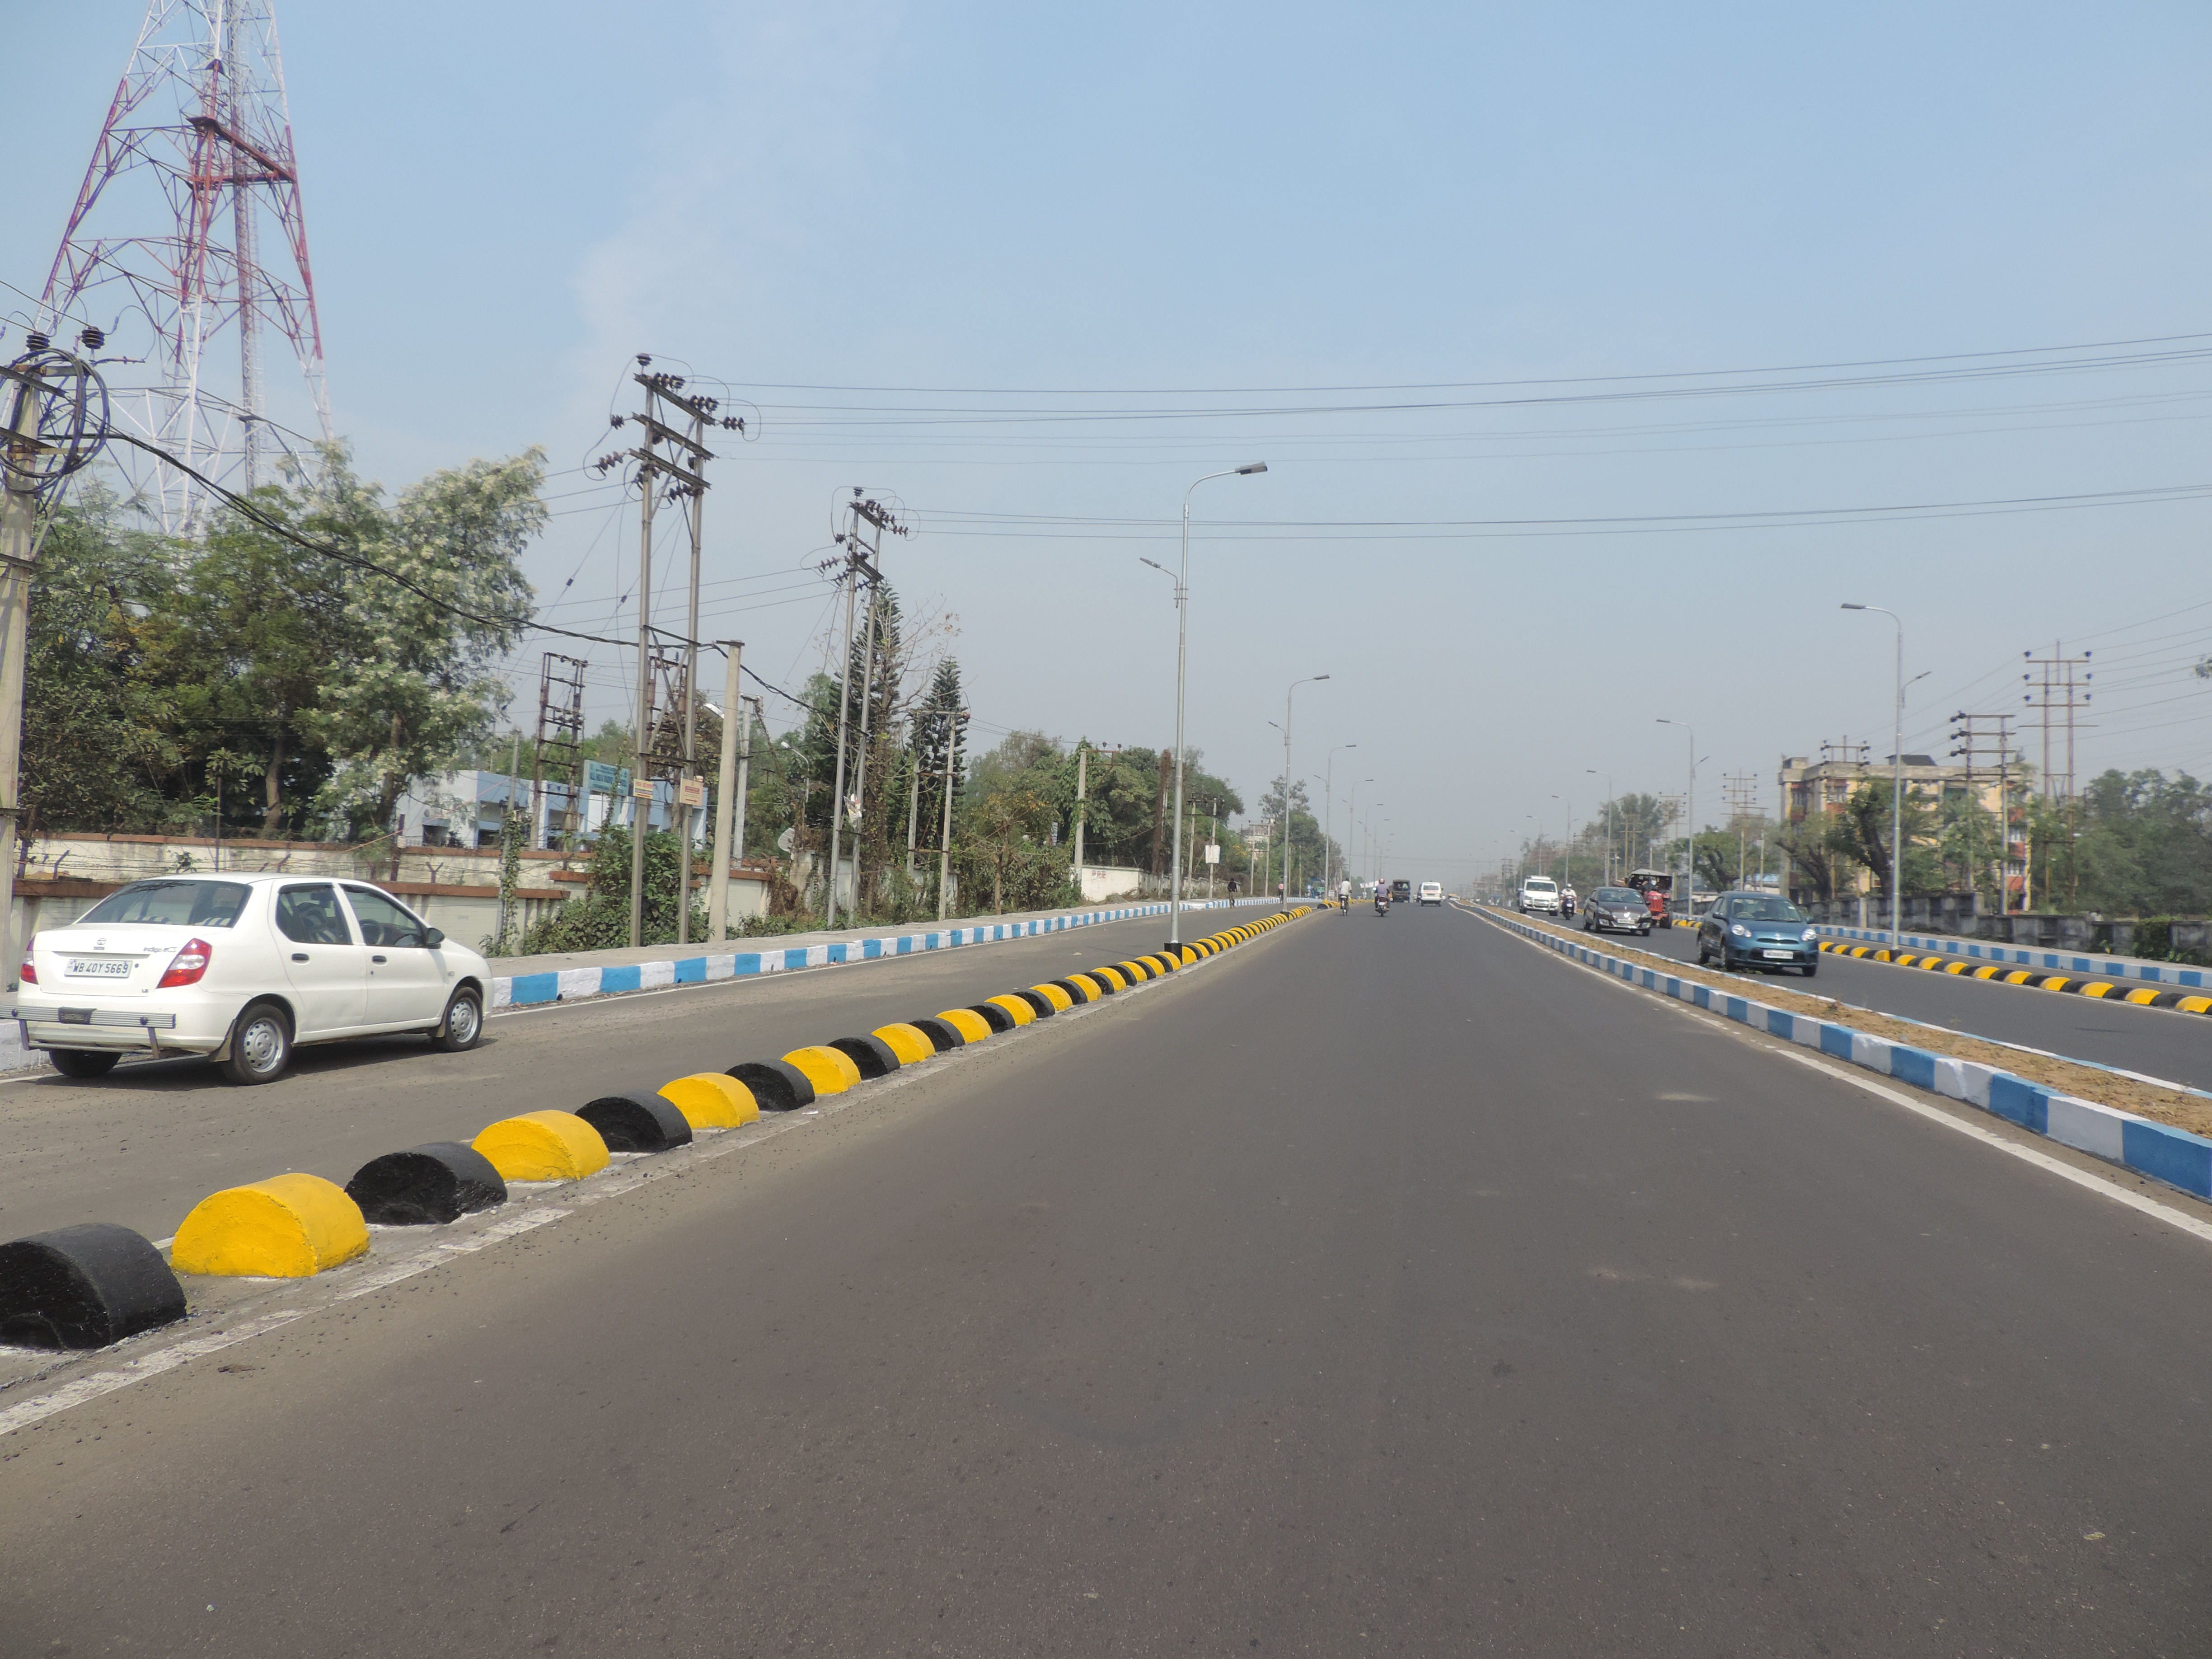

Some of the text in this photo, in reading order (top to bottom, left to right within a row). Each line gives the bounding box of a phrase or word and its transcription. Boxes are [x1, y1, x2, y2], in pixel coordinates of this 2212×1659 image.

[73, 963, 128, 974] WB 40Y 5669
